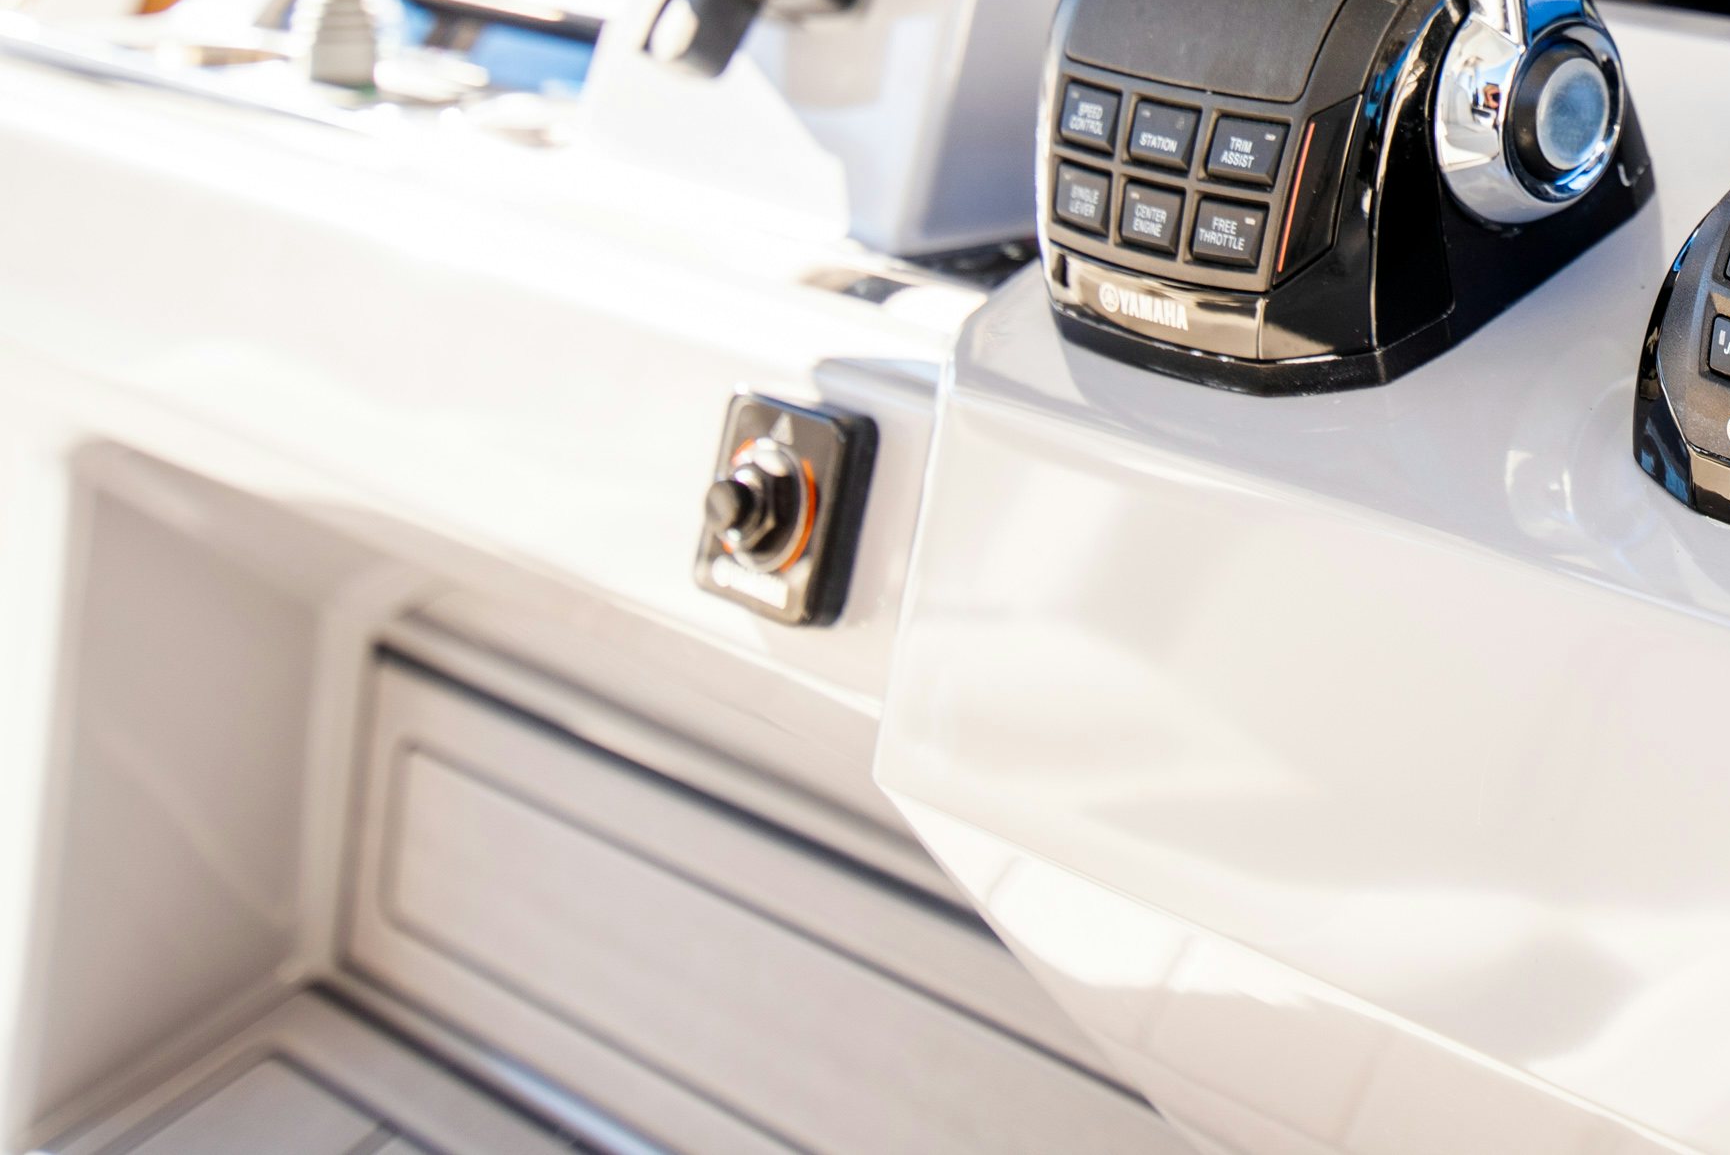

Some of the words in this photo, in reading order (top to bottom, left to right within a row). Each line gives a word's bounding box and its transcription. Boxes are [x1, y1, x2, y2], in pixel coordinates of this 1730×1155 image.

[1077, 102, 1103, 120] SPEED
[1069, 115, 1103, 135] CONTROL
[1139, 133, 1178, 153] STATION
[1230, 137, 1253, 152] TRIM
[1221, 151, 1254, 168] ASSIST
[1071, 185, 1099, 205] SINGLE
[1069, 198, 1096, 218] LEVER
[1134, 204, 1167, 223] CENTER
[1133, 218, 1162, 237] ENGINE
[1212, 217, 1238, 234] FREE
[1199, 229, 1245, 251] THROTTLE
[1119, 286, 1189, 331] YAMAHA
